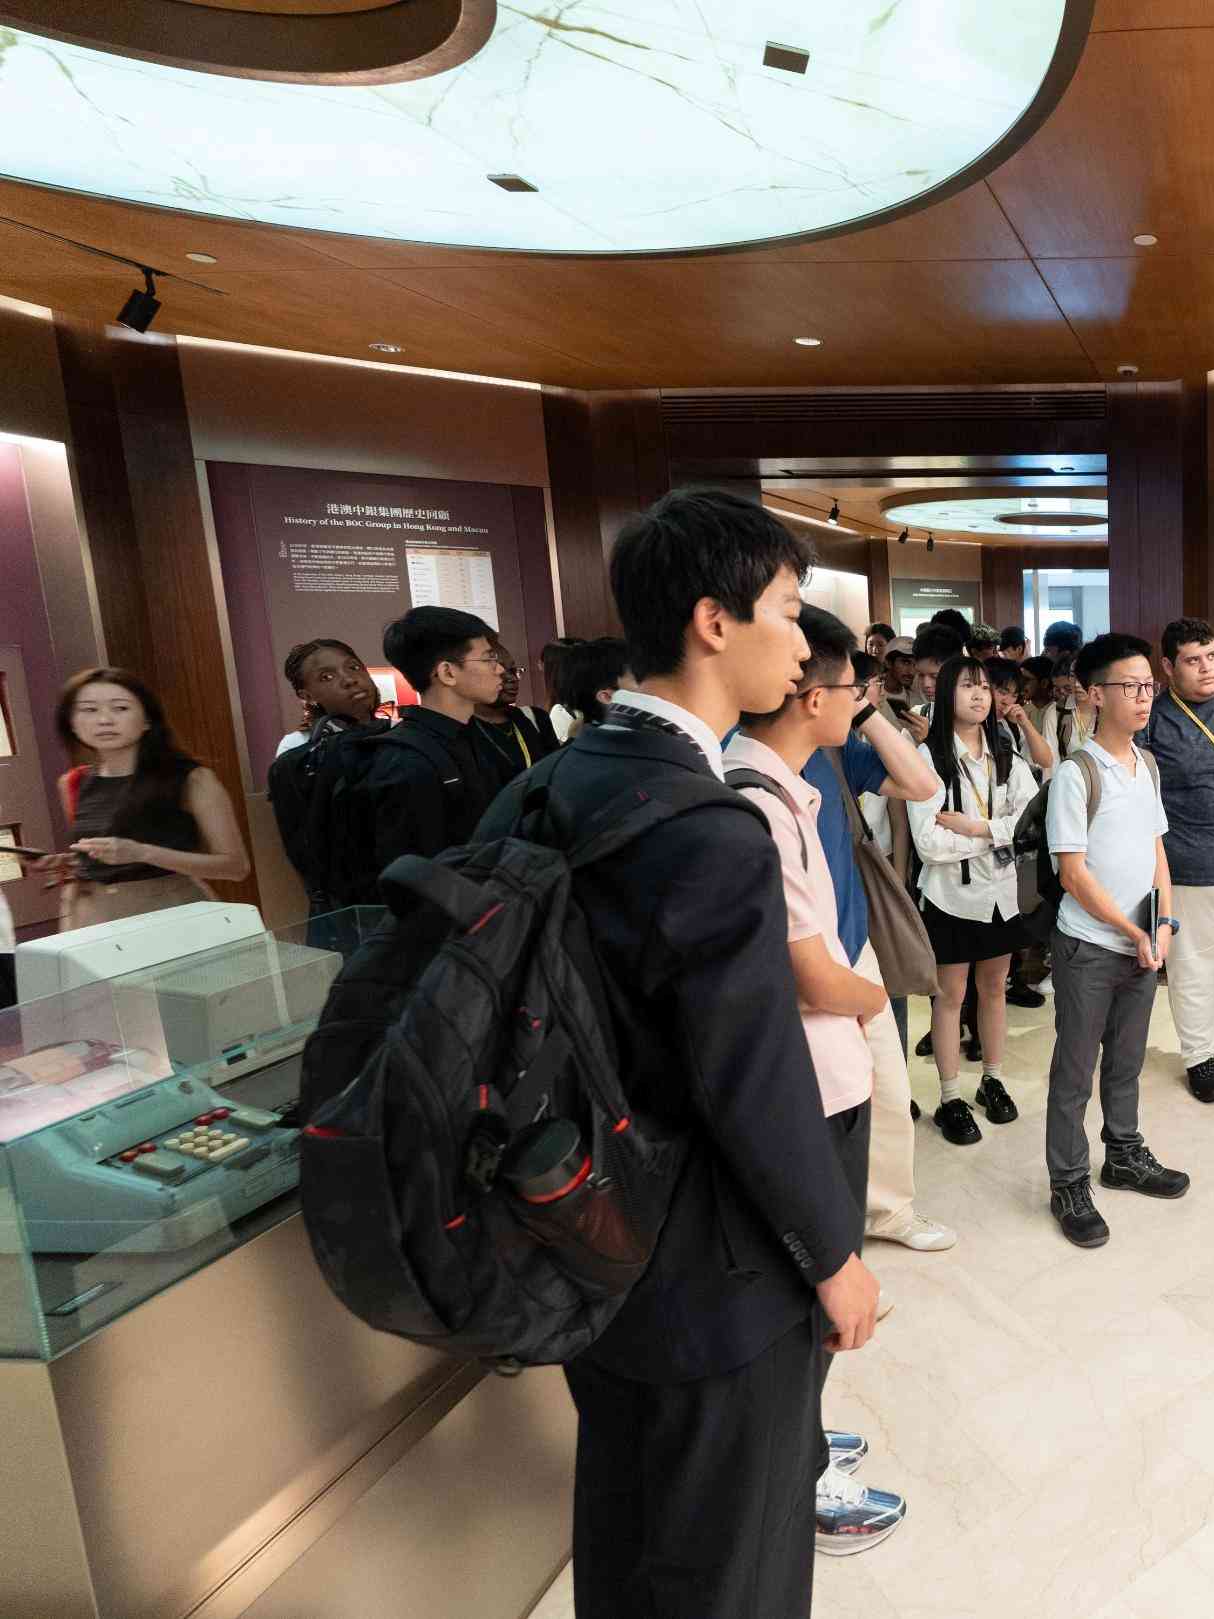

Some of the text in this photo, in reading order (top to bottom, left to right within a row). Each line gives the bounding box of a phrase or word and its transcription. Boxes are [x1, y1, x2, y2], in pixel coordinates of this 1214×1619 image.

[284, 517, 489, 534] History of the BOC Group in Hong Kong and Macau
